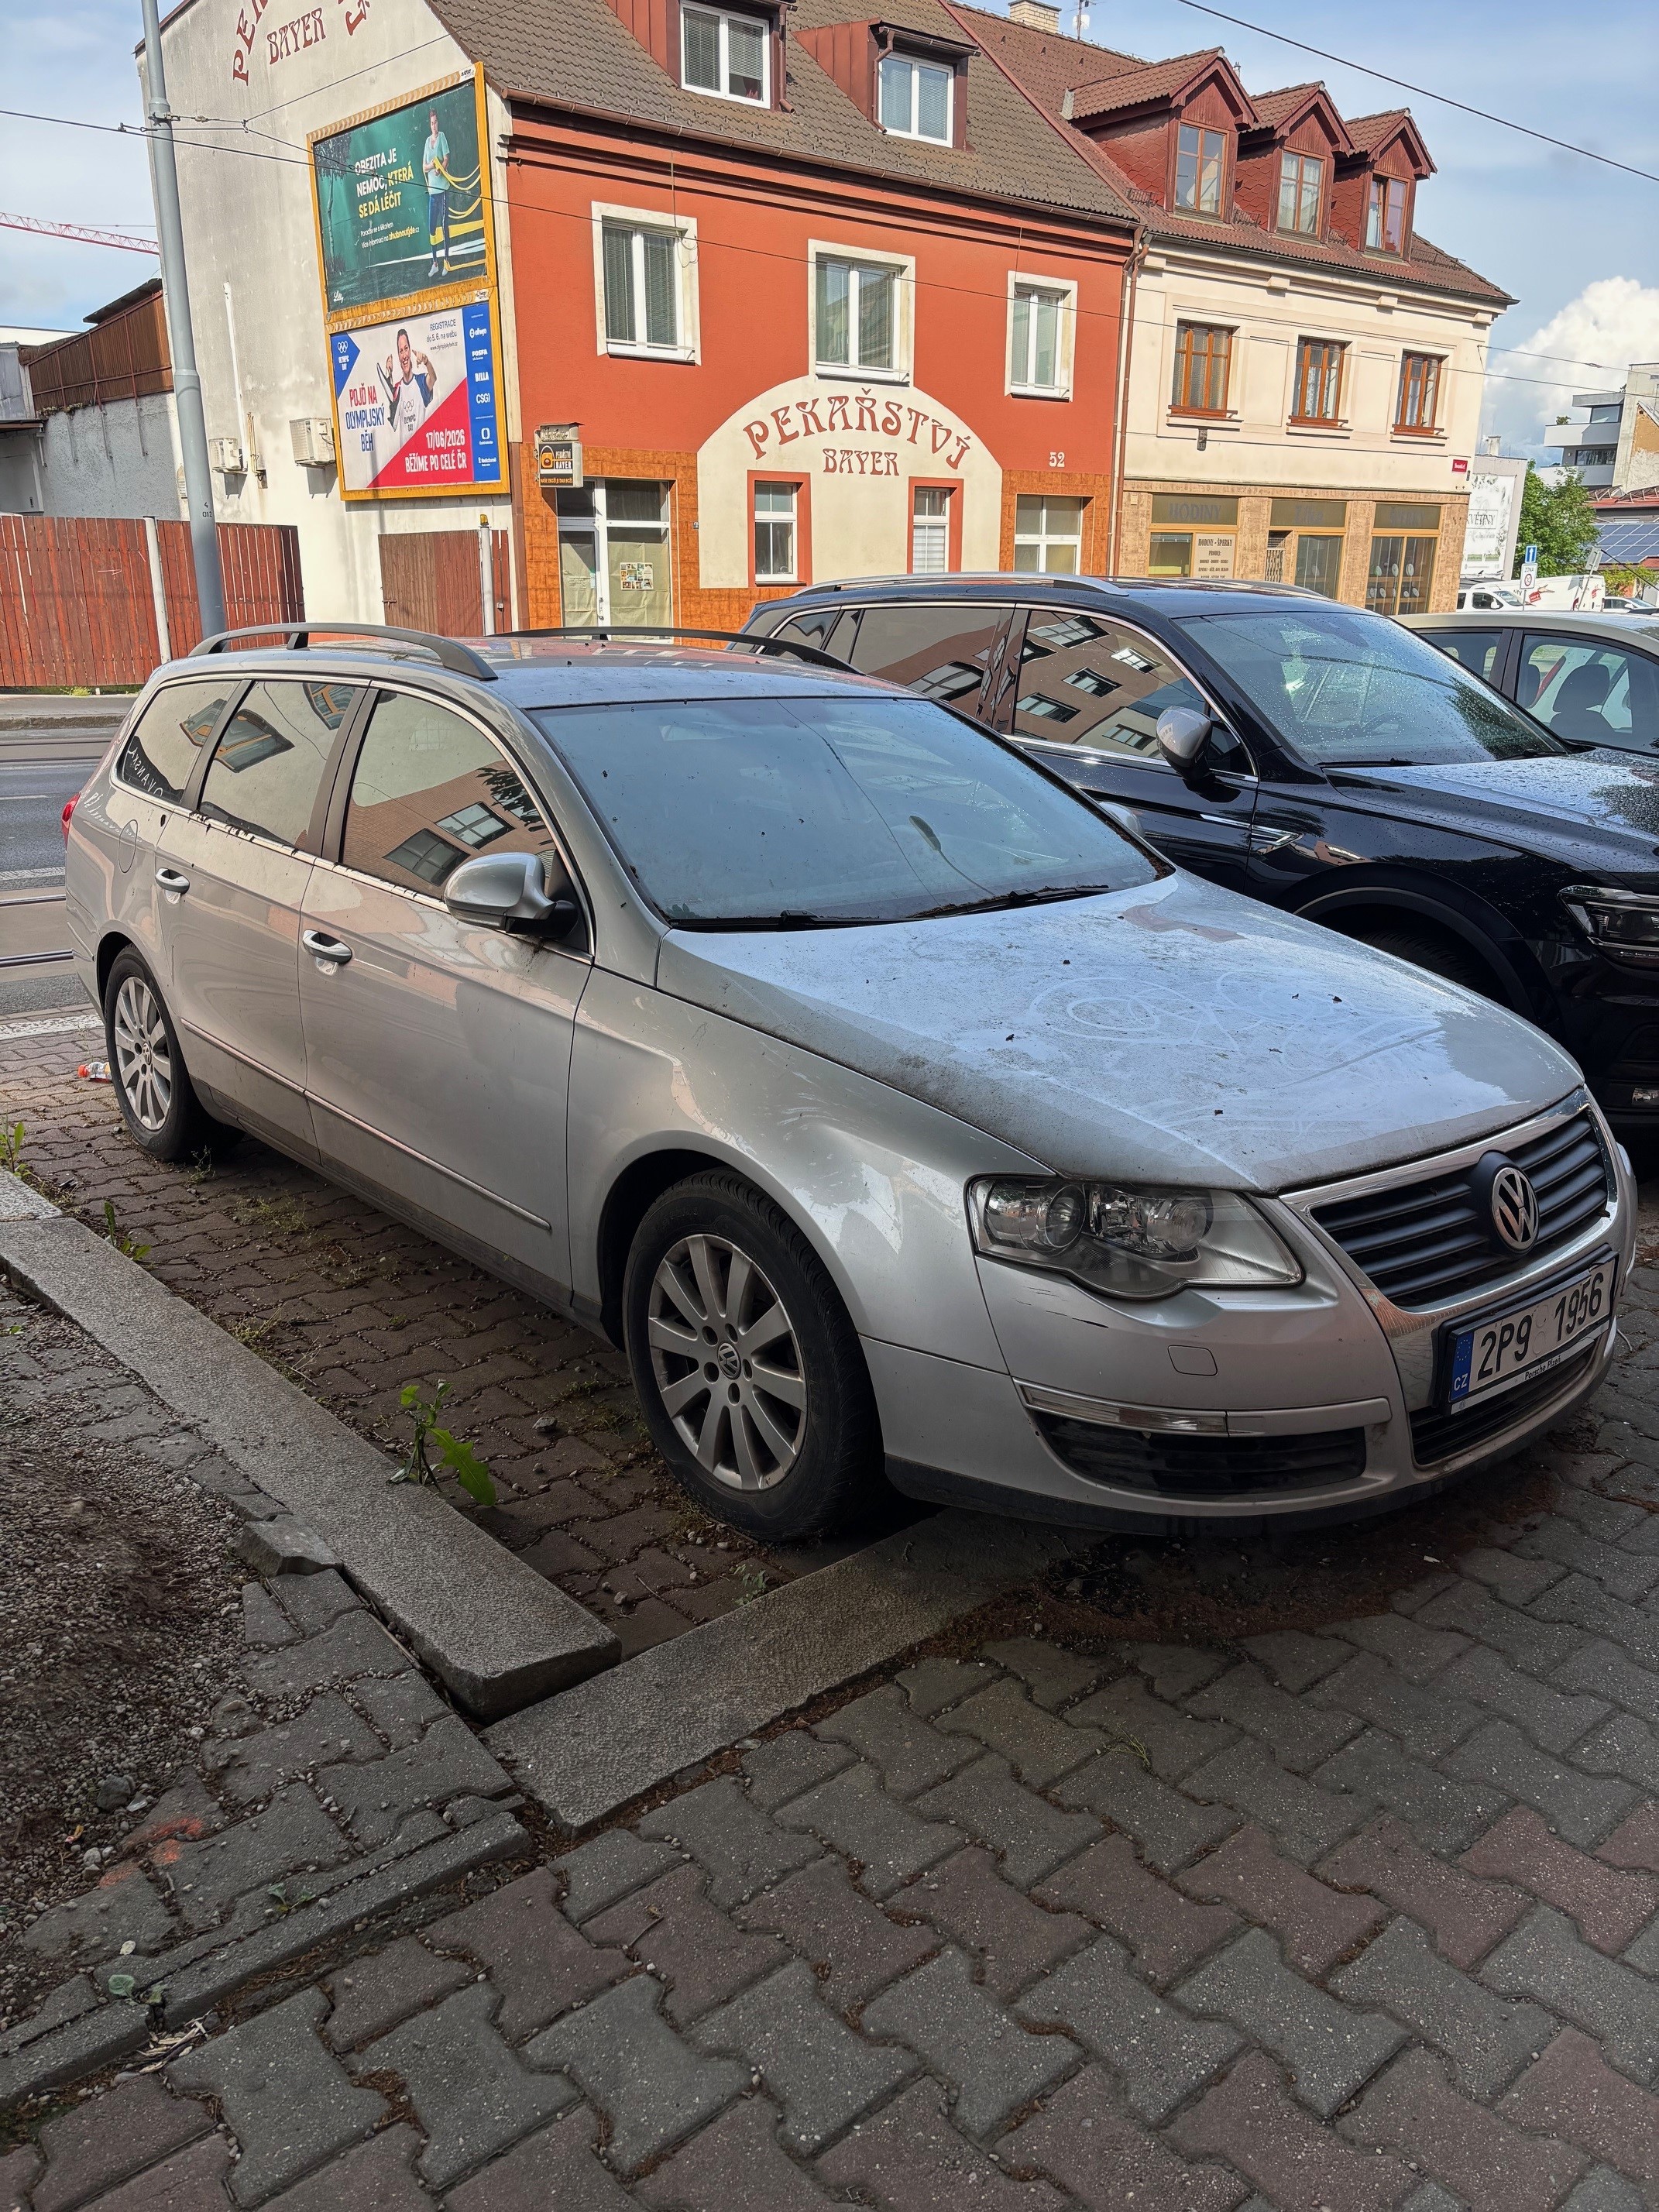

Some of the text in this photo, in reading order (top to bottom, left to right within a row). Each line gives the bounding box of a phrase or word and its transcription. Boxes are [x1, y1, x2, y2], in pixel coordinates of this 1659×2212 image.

[267, 7, 326, 65] BAYER
[355, 147, 397, 176] OBEZITA JE
[356, 160, 414, 198] NEMOC, KTERÁ
[359, 190, 402, 218] SE DÁ LÉČIT
[430, 318, 456, 331] REGISTRACE
[446, 330, 457, 338] webu
[475, 372, 489, 382] BILLA
[349, 383, 378, 407] POJĎ NA
[345, 403, 385, 430] OLYMPIJSKÝ
[743, 387, 971, 470] PEKAŘSTVÍ
[361, 429, 373, 452] BĚH
[425, 428, 465, 451] 17/06/2026
[404, 448, 467, 473] BĚŽÍME PO CELÉ ČR
[823, 448, 900, 476] BAYER
[1049, 451, 1065, 468] 52
[1170, 502, 1222, 521] HODINY
[1477, 1272, 1604, 1382] 2P9 1956
[1453, 1372, 1468, 1392] CZ
[1524, 1364, 1546, 1380] Porsche
